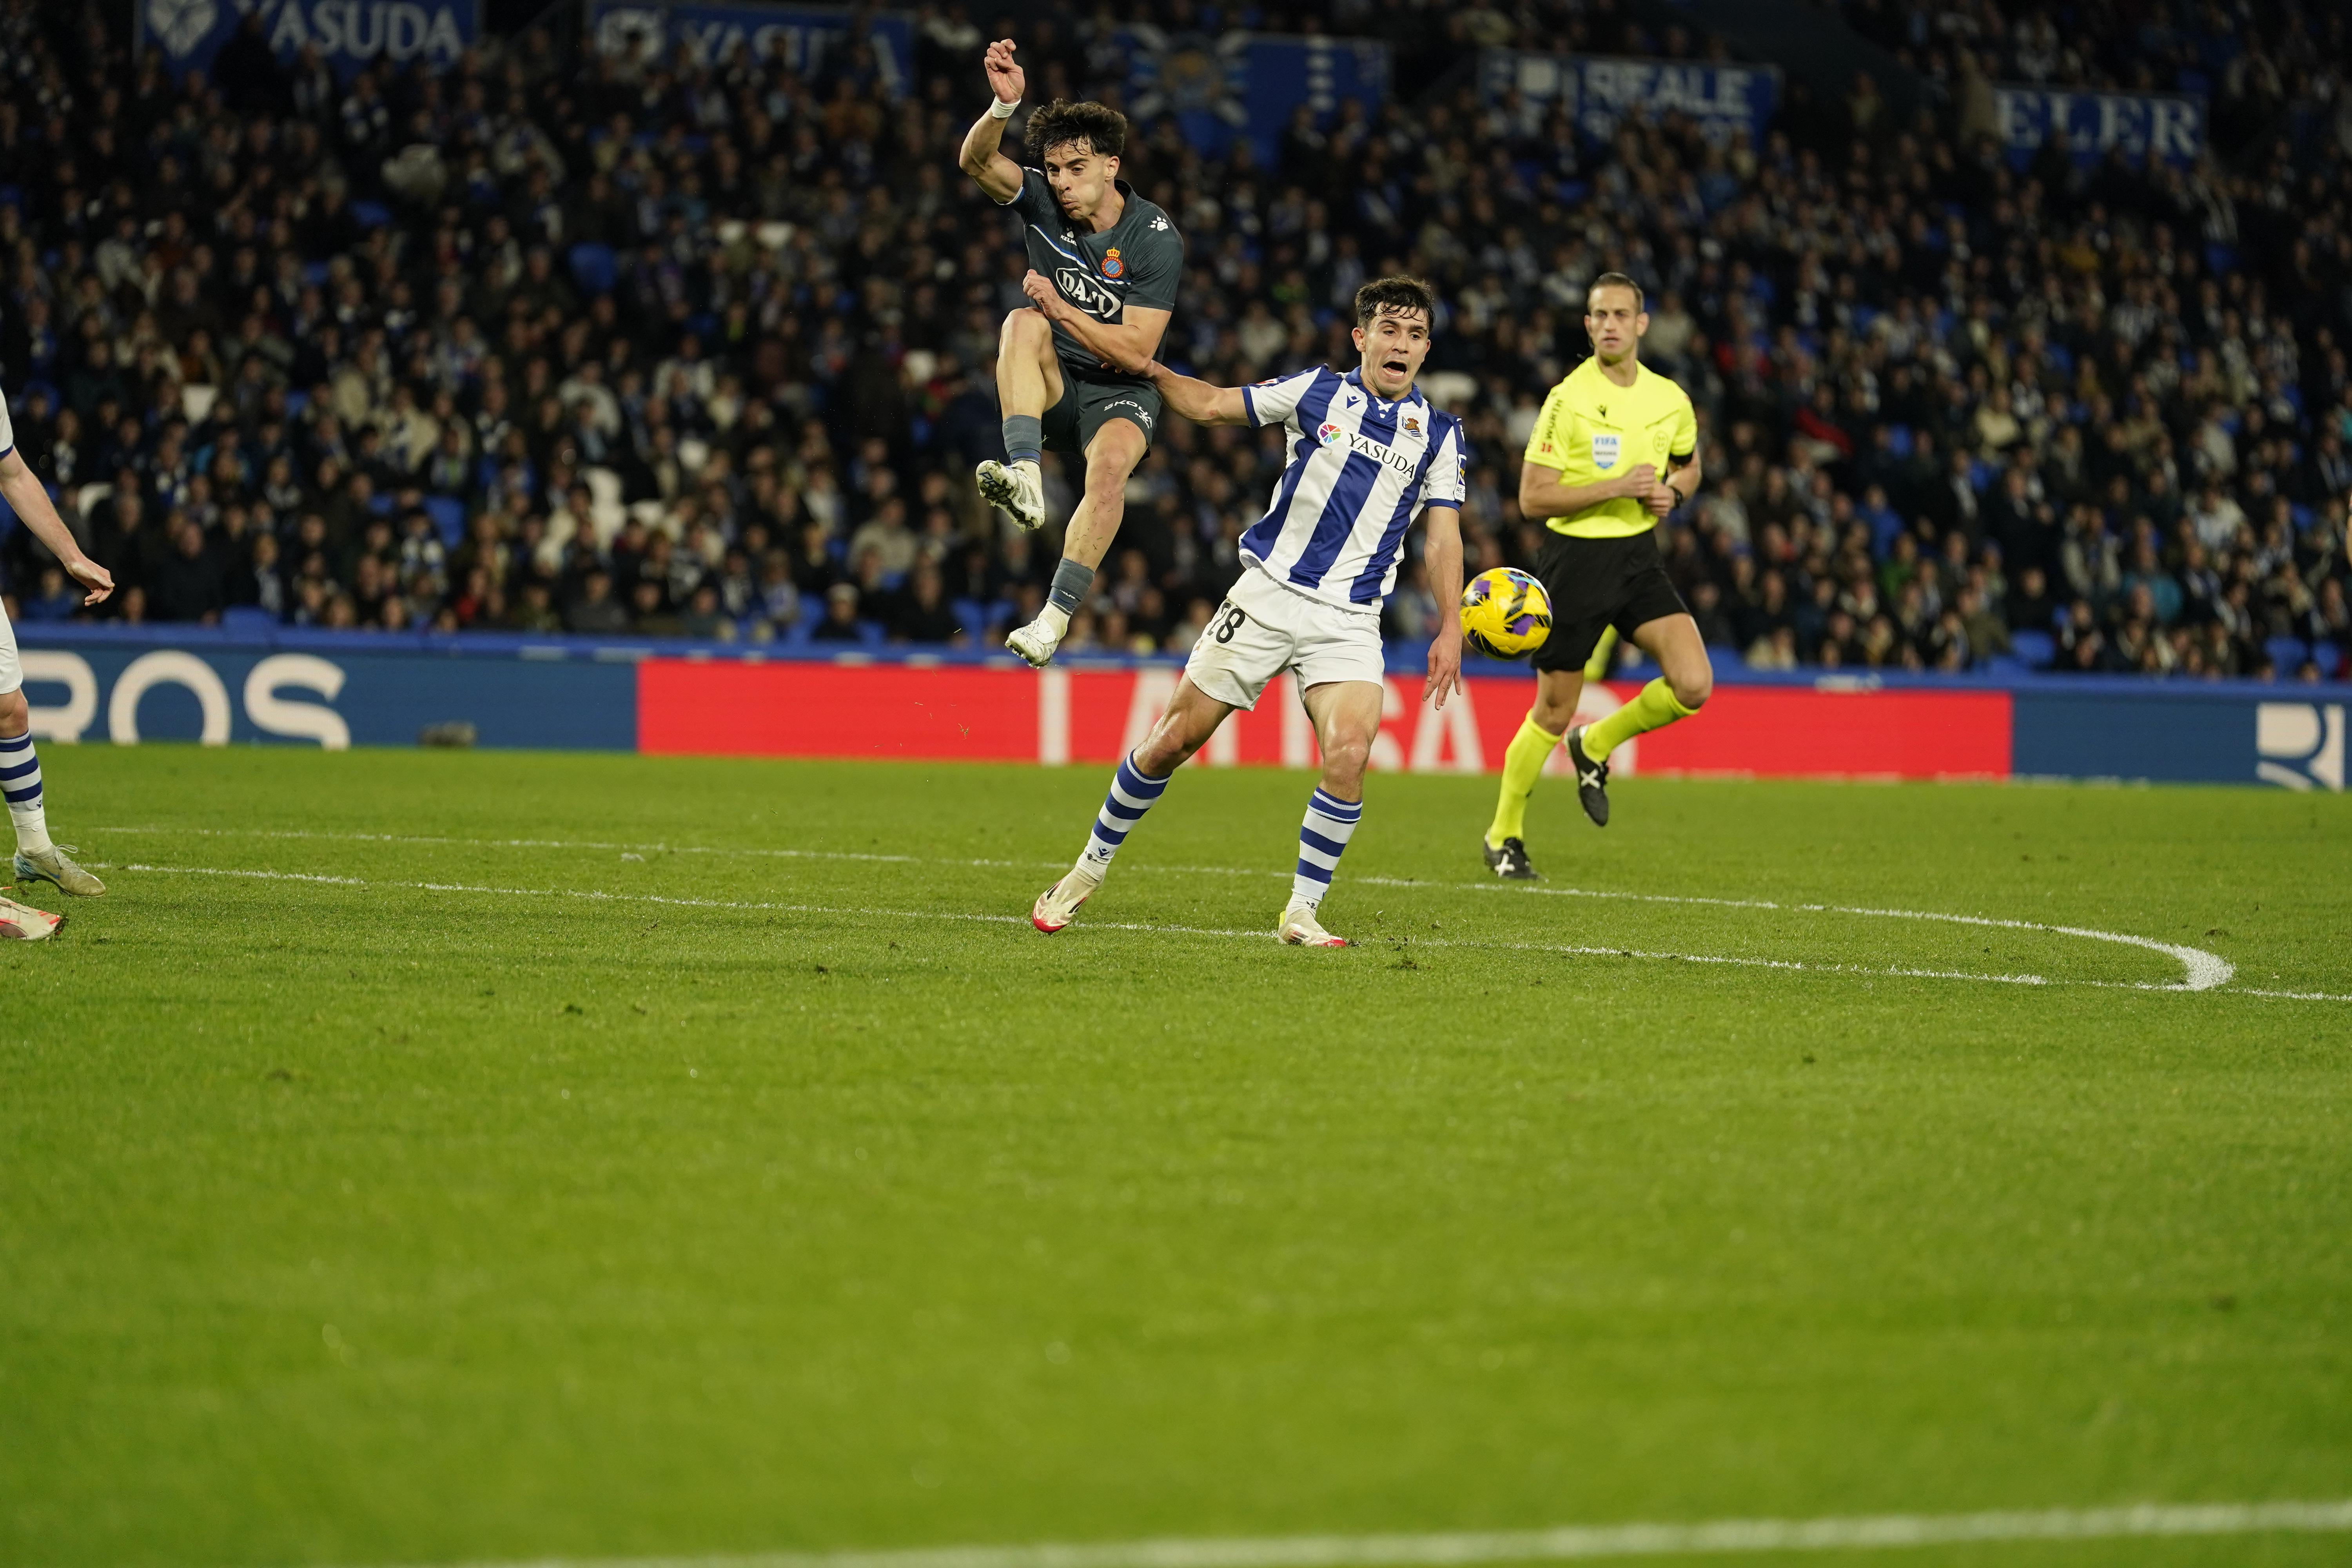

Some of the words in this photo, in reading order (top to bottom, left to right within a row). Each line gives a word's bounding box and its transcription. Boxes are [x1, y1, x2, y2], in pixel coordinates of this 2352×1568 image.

[1595, 437, 1617, 445] FIFA
[1348, 433, 1415, 479] YASUDA
[1398, 474, 1411, 485] group
